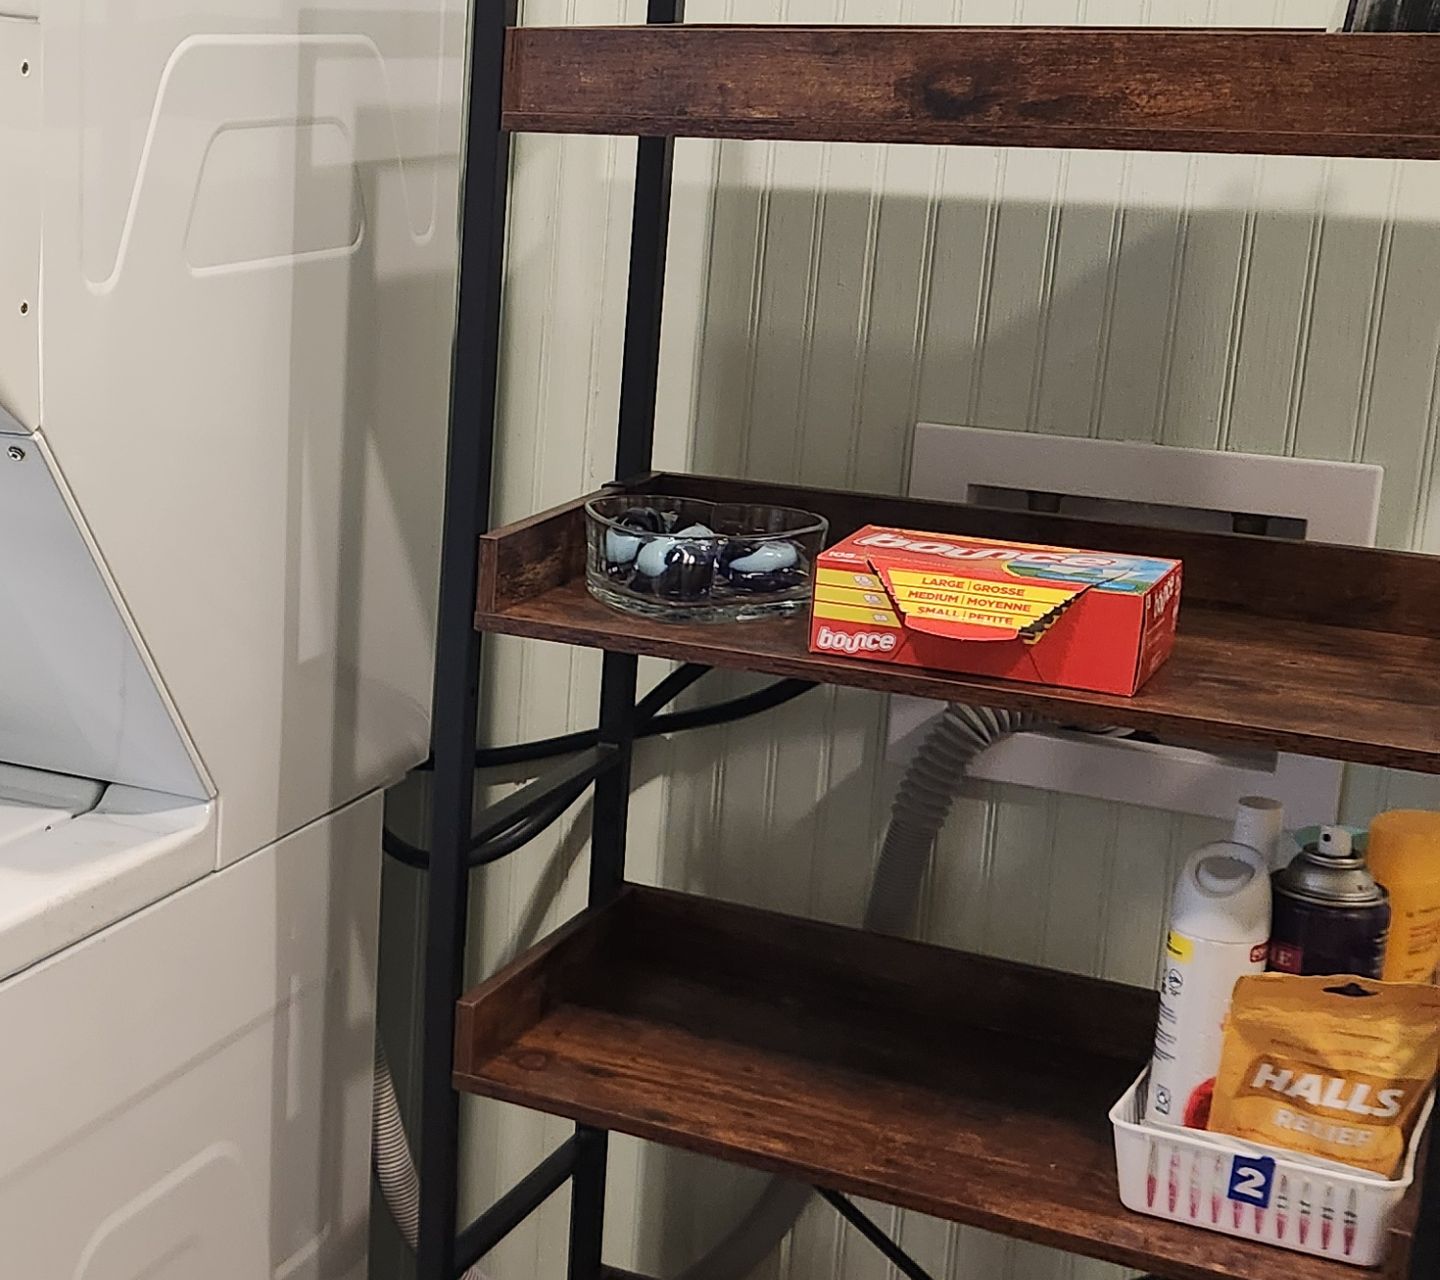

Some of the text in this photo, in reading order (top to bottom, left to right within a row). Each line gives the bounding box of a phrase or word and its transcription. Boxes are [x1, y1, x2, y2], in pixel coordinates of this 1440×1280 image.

[854, 532, 1120, 568] bounce
[908, 590, 1031, 612] MEDIUM MOYENNE
[922, 577, 1025, 596] LARGE GROSSE
[917, 606, 1013, 625] SMALL PETITE
[817, 626, 896, 653] bounce
[1252, 1063, 1405, 1118] HALLS
[1274, 1109, 1374, 1146] RELIEF
[1233, 1166, 1266, 1199] 2
